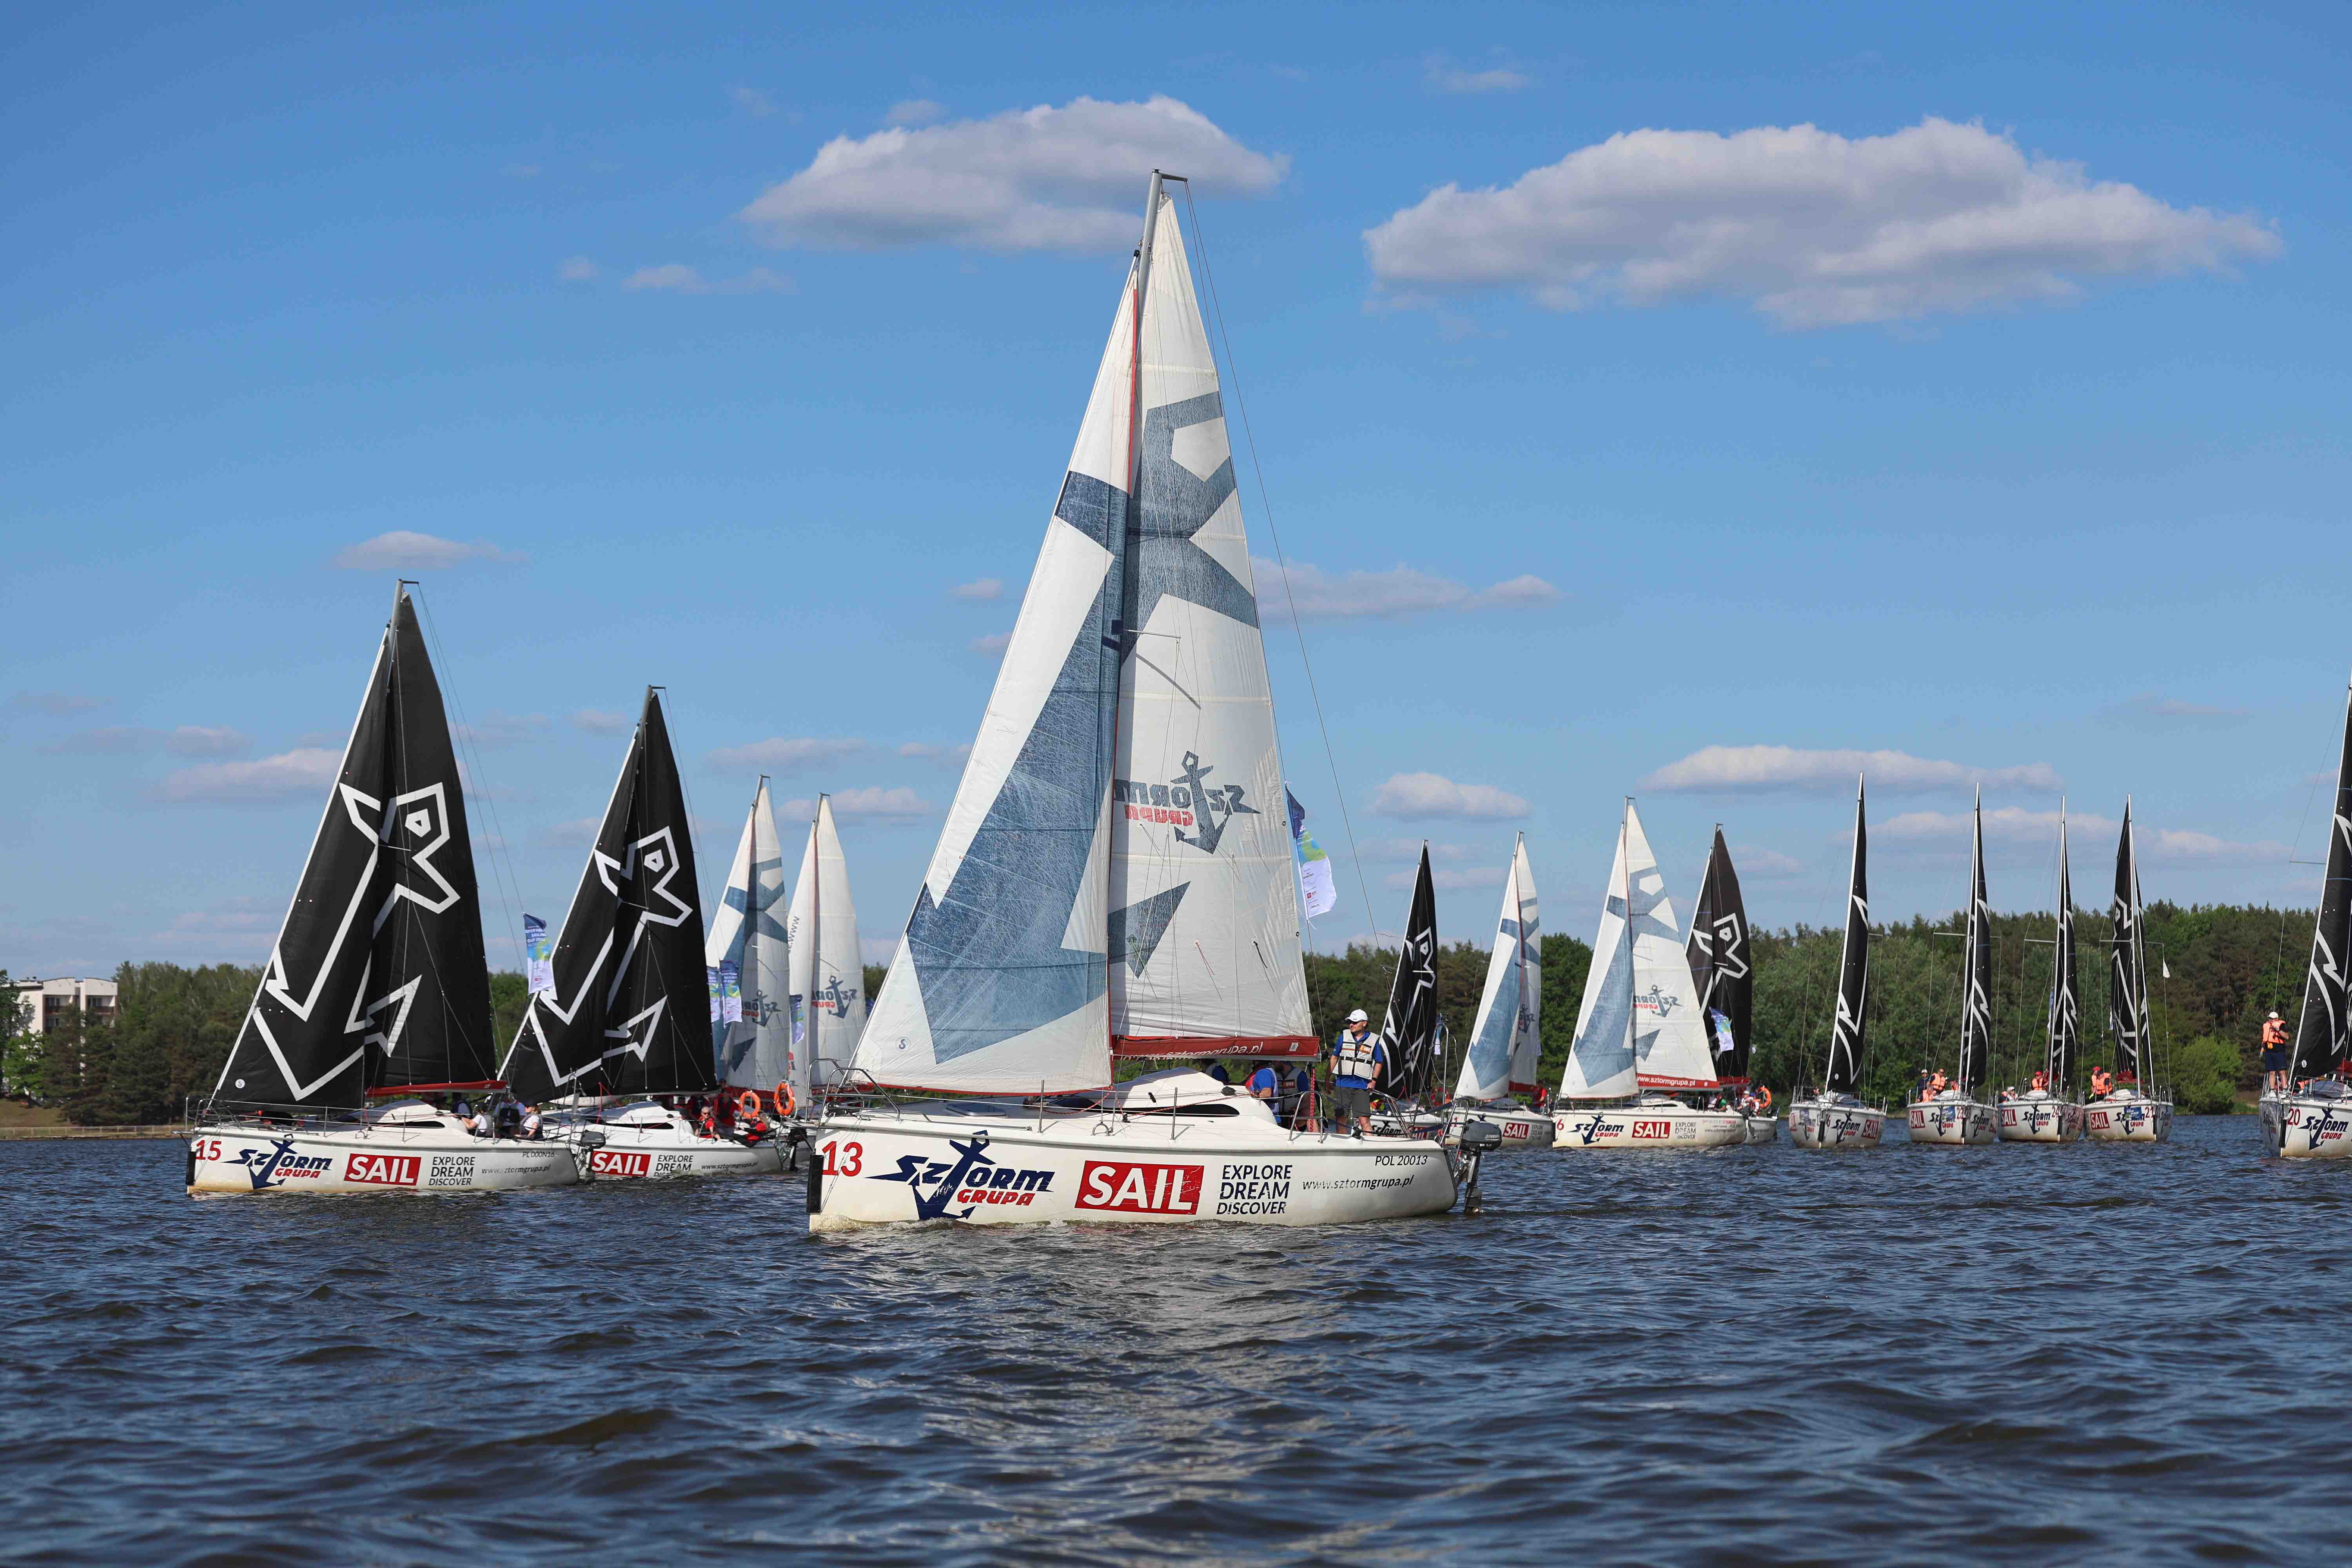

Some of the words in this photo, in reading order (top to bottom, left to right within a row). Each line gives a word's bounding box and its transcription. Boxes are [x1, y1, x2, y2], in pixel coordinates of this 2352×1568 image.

[1557, 1119, 1564, 1130] 6
[1911, 1111, 1925, 1128] SAIL
[2001, 1110, 2016, 1126] SAIL
[2091, 1112, 2109, 1129] SAIL
[2287, 1108, 2300, 1125] 20
[1504, 1123, 1528, 1139] SAIL
[1634, 1122, 1669, 1138] SAIL
[1863, 1121, 1878, 1138] SAIL
[195, 1140, 222, 1161] 15
[432, 1156, 475, 1166] EXPLORE
[592, 1153, 646, 1176] SAIL
[655, 1163, 691, 1171] DREAM
[821, 1141, 863, 1177] 13
[1375, 1155, 1395, 1166] POL
[1397, 1155, 1428, 1165] 20013
[275, 1168, 321, 1178] GRUPA
[348, 1156, 416, 1183] SAIL
[430, 1166, 474, 1177] DREAM
[1222, 1165, 1293, 1180] EXPLORE
[428, 1178, 471, 1186] DISCOVER
[1082, 1165, 1193, 1210] SAIL
[1302, 1174, 1415, 1190] www.sztormgrupa.pl
[957, 1189, 1036, 1206] GRUPA
[1219, 1181, 1290, 1200] DREAM
[1216, 1201, 1287, 1215] DISCOVER
